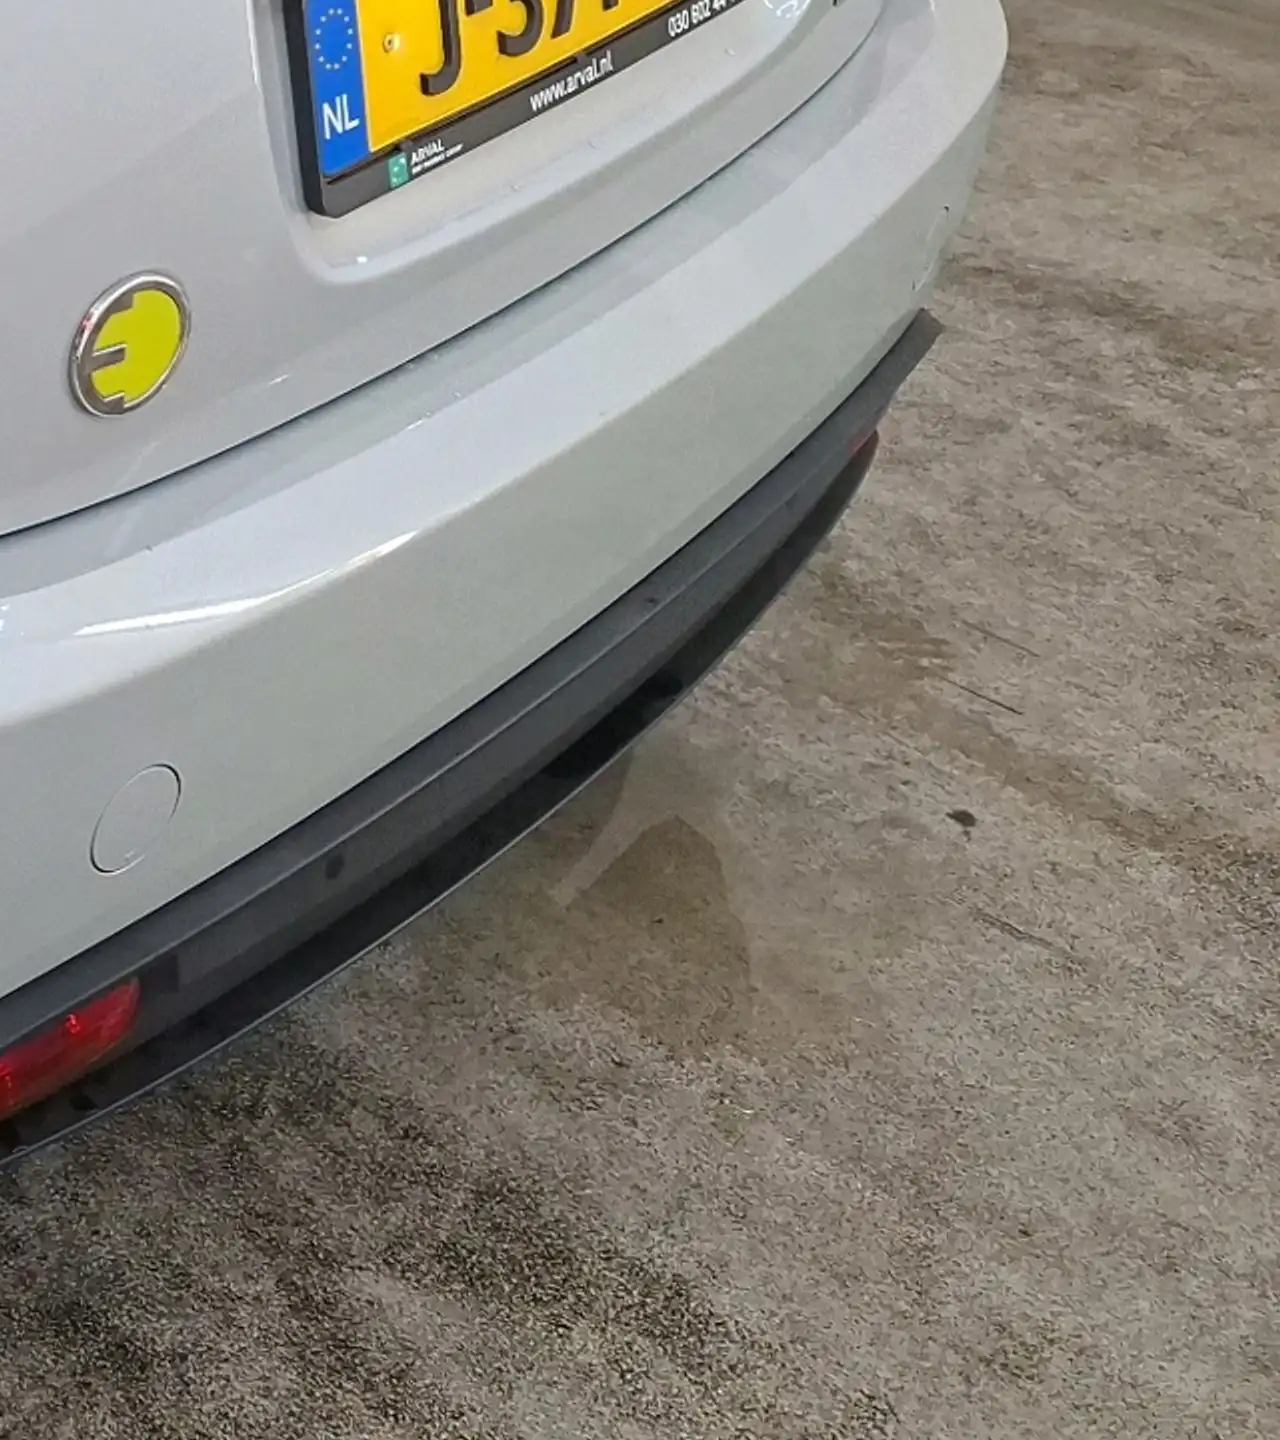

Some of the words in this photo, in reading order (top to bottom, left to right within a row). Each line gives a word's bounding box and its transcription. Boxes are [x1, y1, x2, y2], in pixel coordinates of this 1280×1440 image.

[668, 9, 689, 37] 030
[530, 50, 613, 111] www.arval.nl
[322, 93, 360, 140] NL
[411, 139, 445, 166] ARVAL
